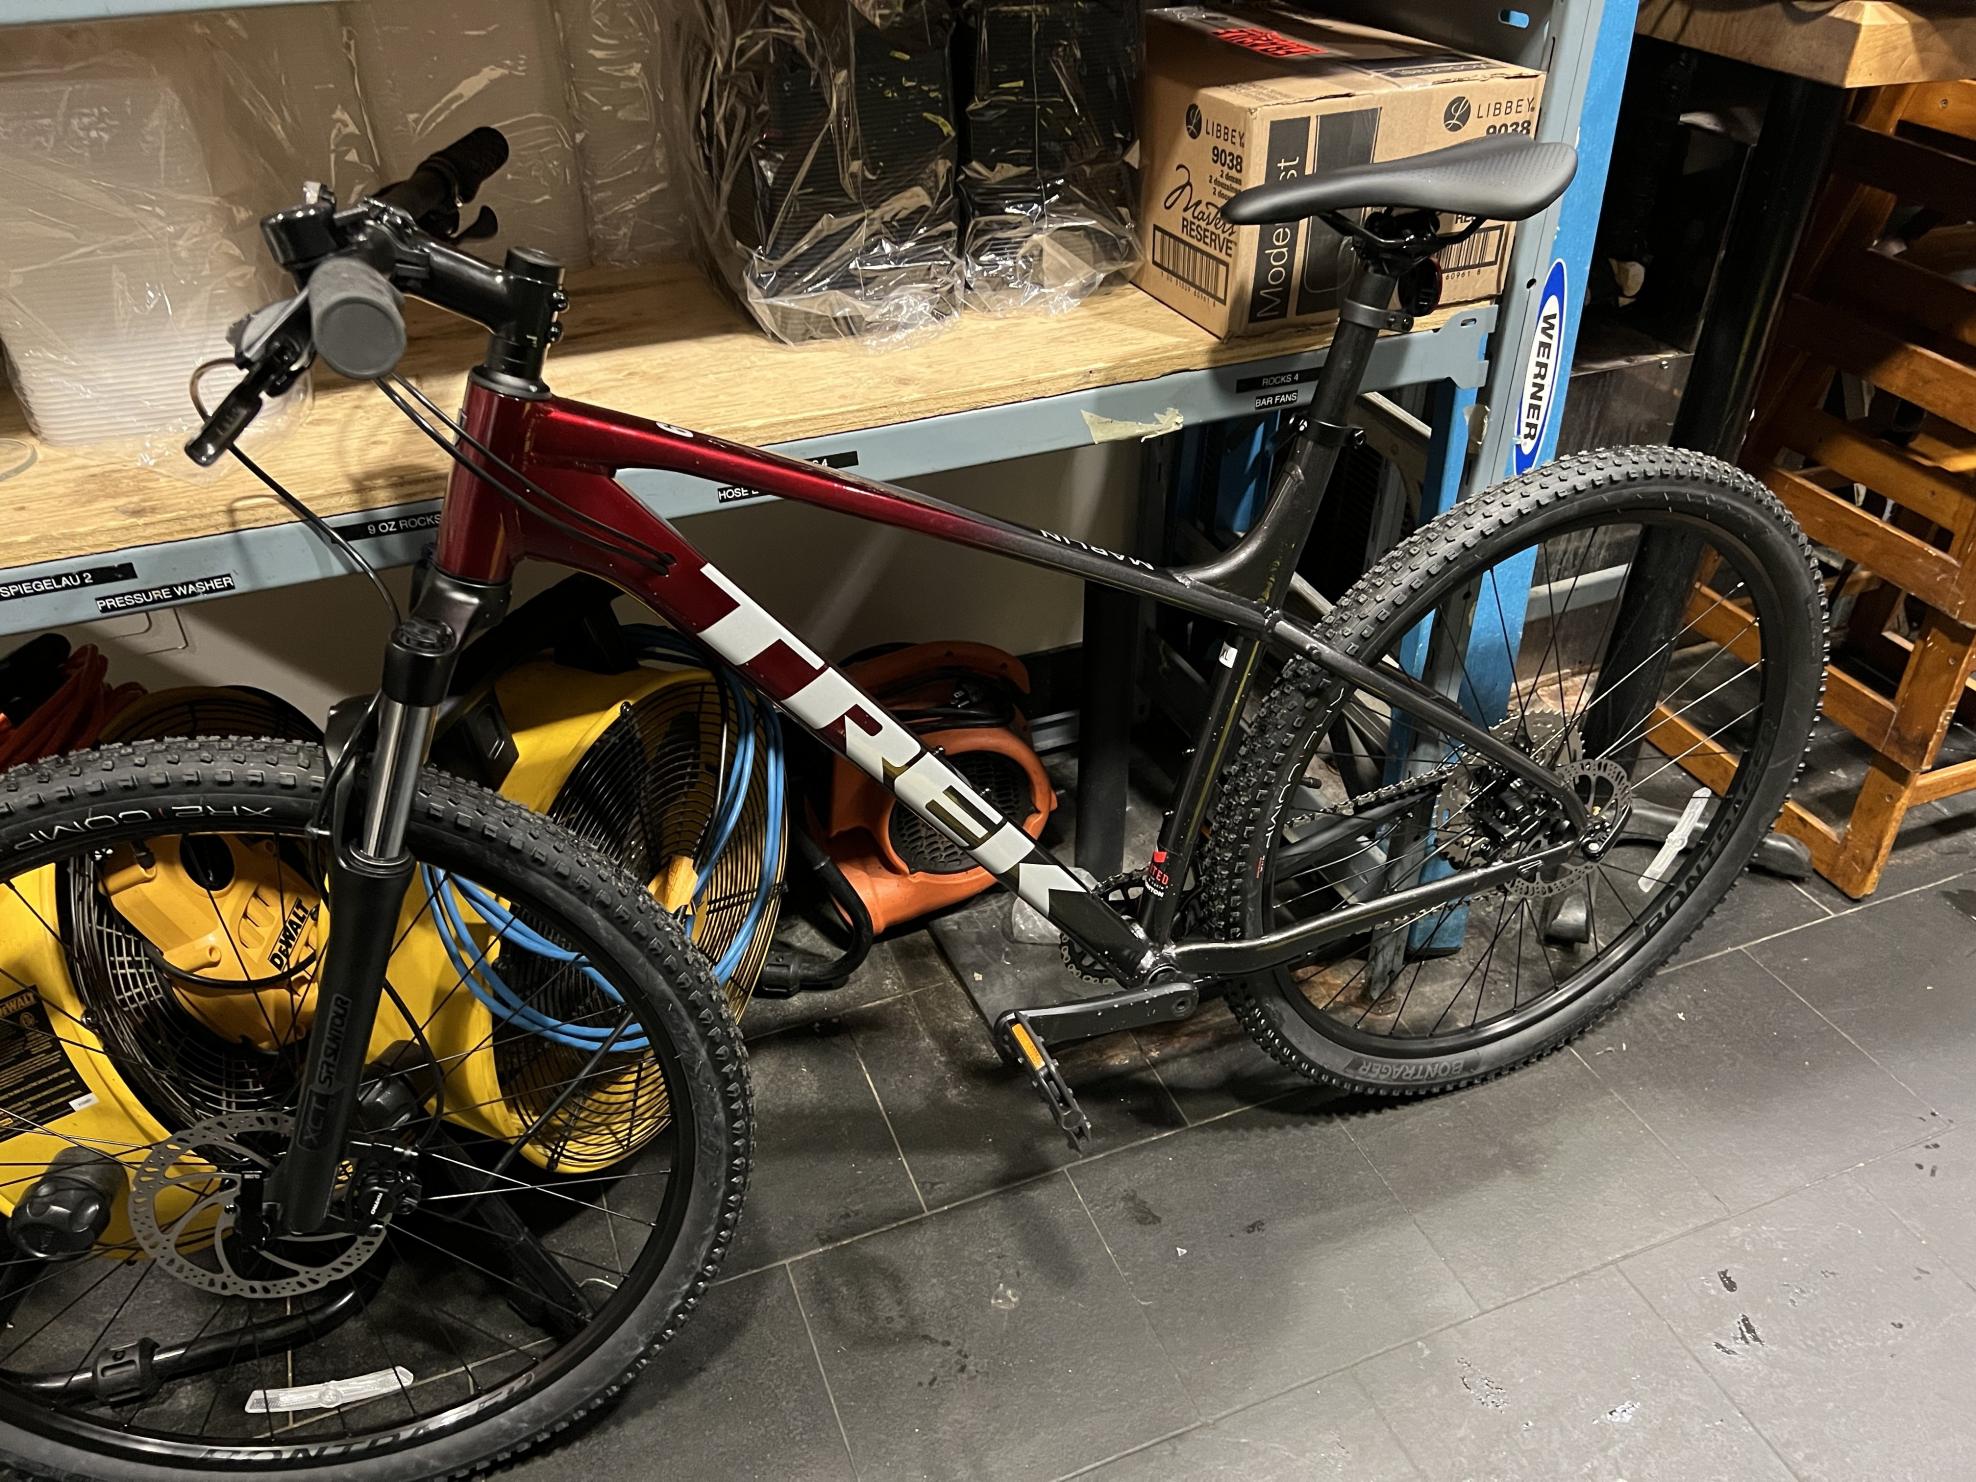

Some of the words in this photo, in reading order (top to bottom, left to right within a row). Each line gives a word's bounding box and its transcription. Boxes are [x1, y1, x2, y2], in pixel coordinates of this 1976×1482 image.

[1477, 97, 1534, 119] LIBBEY
[1205, 118, 1245, 146] LIBBEY
[1486, 120, 1531, 135] 9038
[1211, 145, 1243, 174] 9038
[1181, 216, 1234, 259] RESERVE
[1262, 374, 1292, 386] ROCKS
[1524, 313, 1557, 441] WERNER
[1255, 397, 1273, 408] BAR
[1274, 392, 1298, 405] FANS
[718, 487, 750, 500] HOSE
[367, 524, 376, 535] 9
[378, 521, 397, 533] OZ
[399, 513, 441, 530] ROCKS
[0, 573, 81, 598] SPIEGELAU
[83, 572, 93, 584] 2
[97, 589, 172, 611] PRESSURE
[174, 576, 234, 597] WASHER
[696, 562, 1088, 918] TREK
[13, 807, 152, 850] COMP
[1358, 1058, 1464, 1081] BONTRAGER
